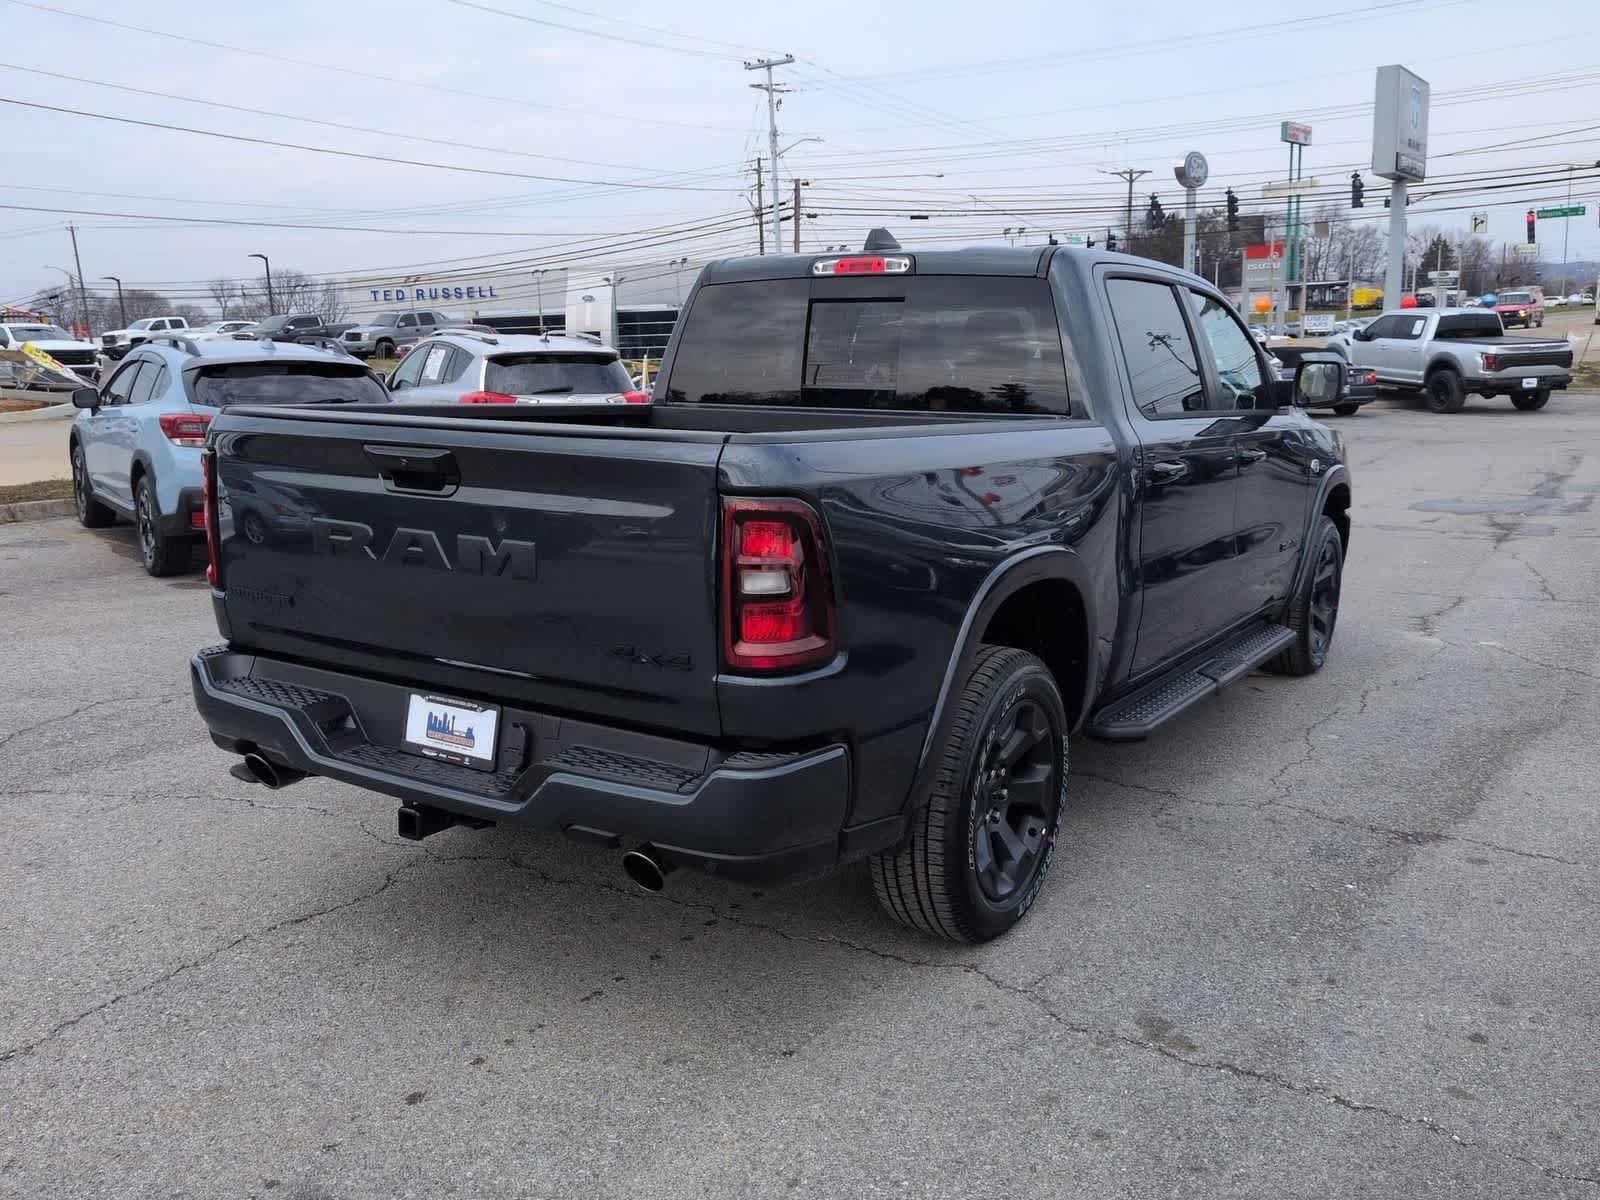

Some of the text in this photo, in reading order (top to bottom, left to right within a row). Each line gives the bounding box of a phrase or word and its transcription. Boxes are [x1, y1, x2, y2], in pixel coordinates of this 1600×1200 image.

[1247, 262, 1281, 271] ISUZU
[370, 285, 498, 302] TED RUSSELL
[312, 517, 538, 581] RAM
